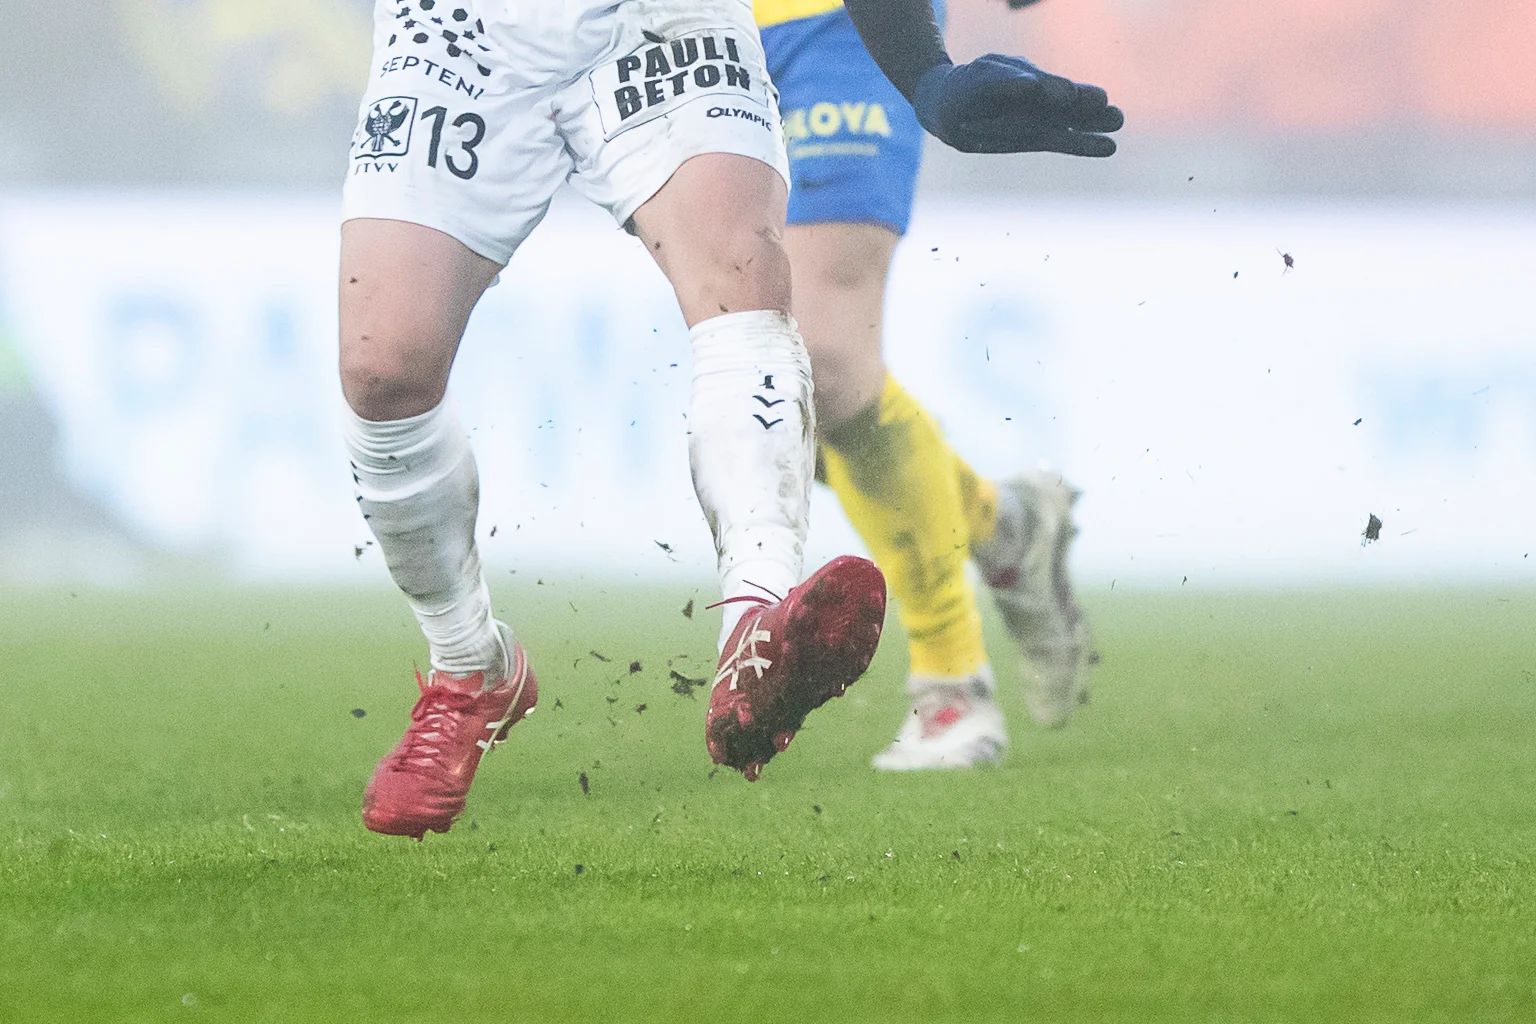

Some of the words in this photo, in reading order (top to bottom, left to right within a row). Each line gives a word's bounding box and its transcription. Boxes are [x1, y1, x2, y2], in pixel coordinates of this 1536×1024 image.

[380, 55, 485, 100] SEPTENI
[616, 36, 740, 84] PAULI
[614, 63, 751, 122] BETON
[420, 105, 487, 180] 13
[706, 106, 773, 132] OLYMPIC
